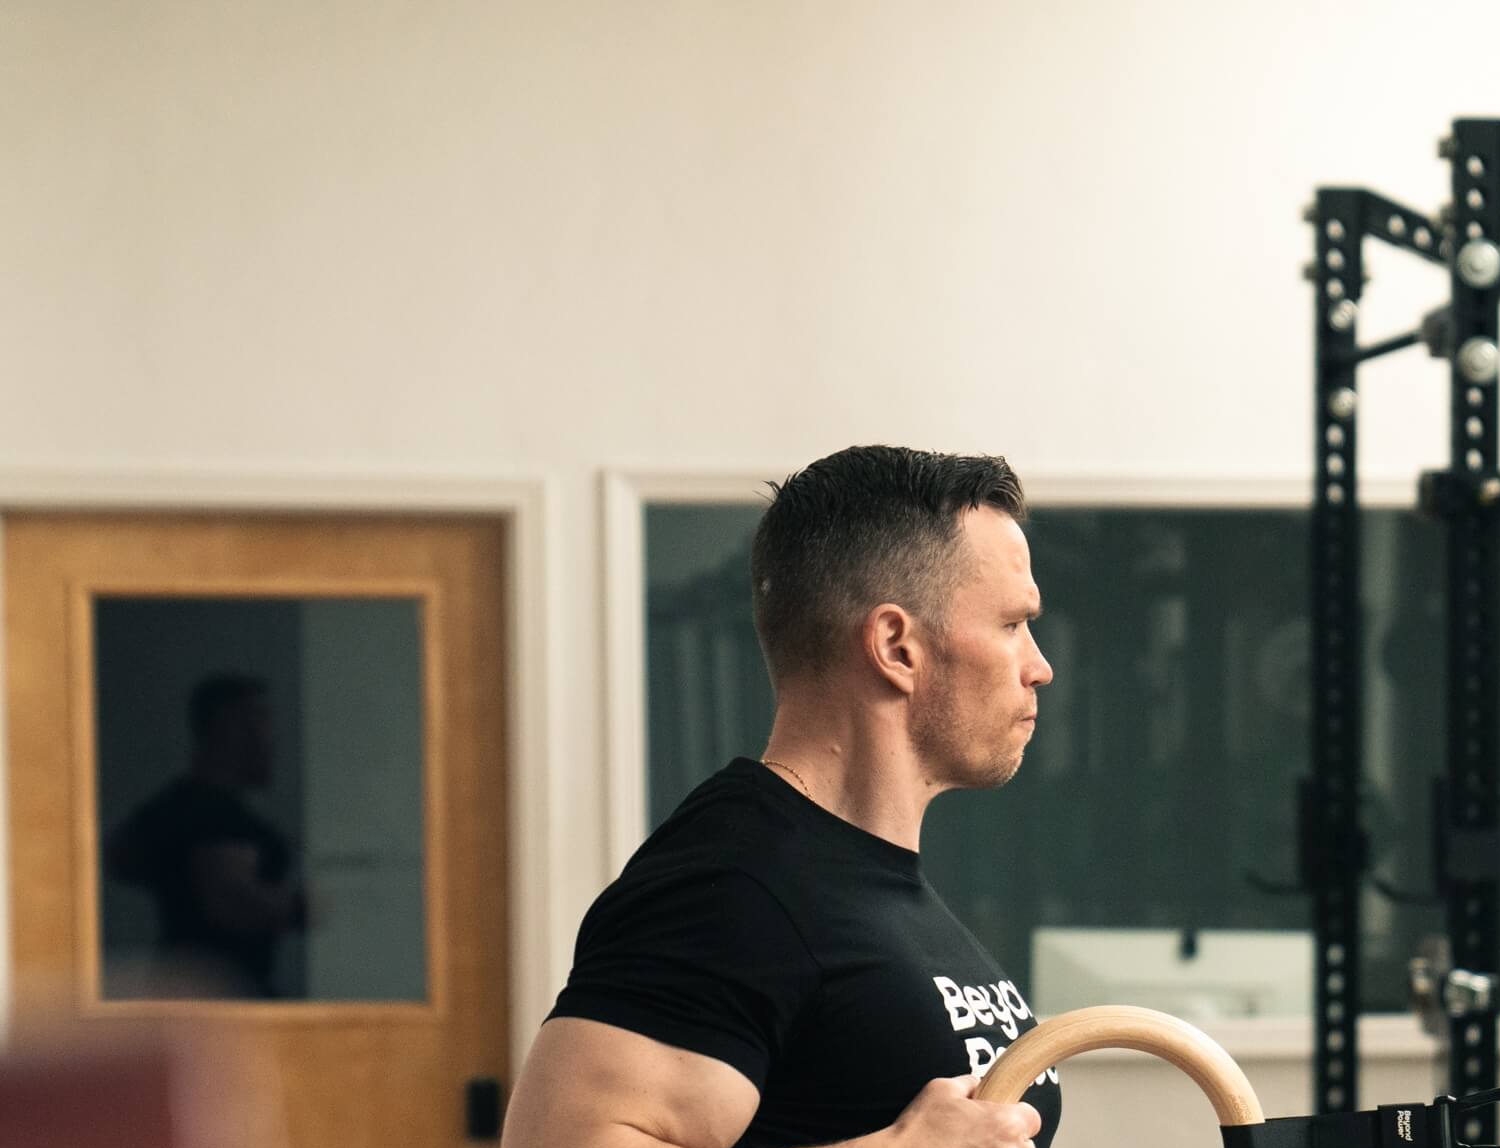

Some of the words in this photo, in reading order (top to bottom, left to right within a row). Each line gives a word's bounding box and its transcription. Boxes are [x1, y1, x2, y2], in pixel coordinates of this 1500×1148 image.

[933, 976, 1033, 1040] Beyo
[1397, 1110, 1406, 1139] Power
[1402, 1110, 1414, 1142] Beyond
